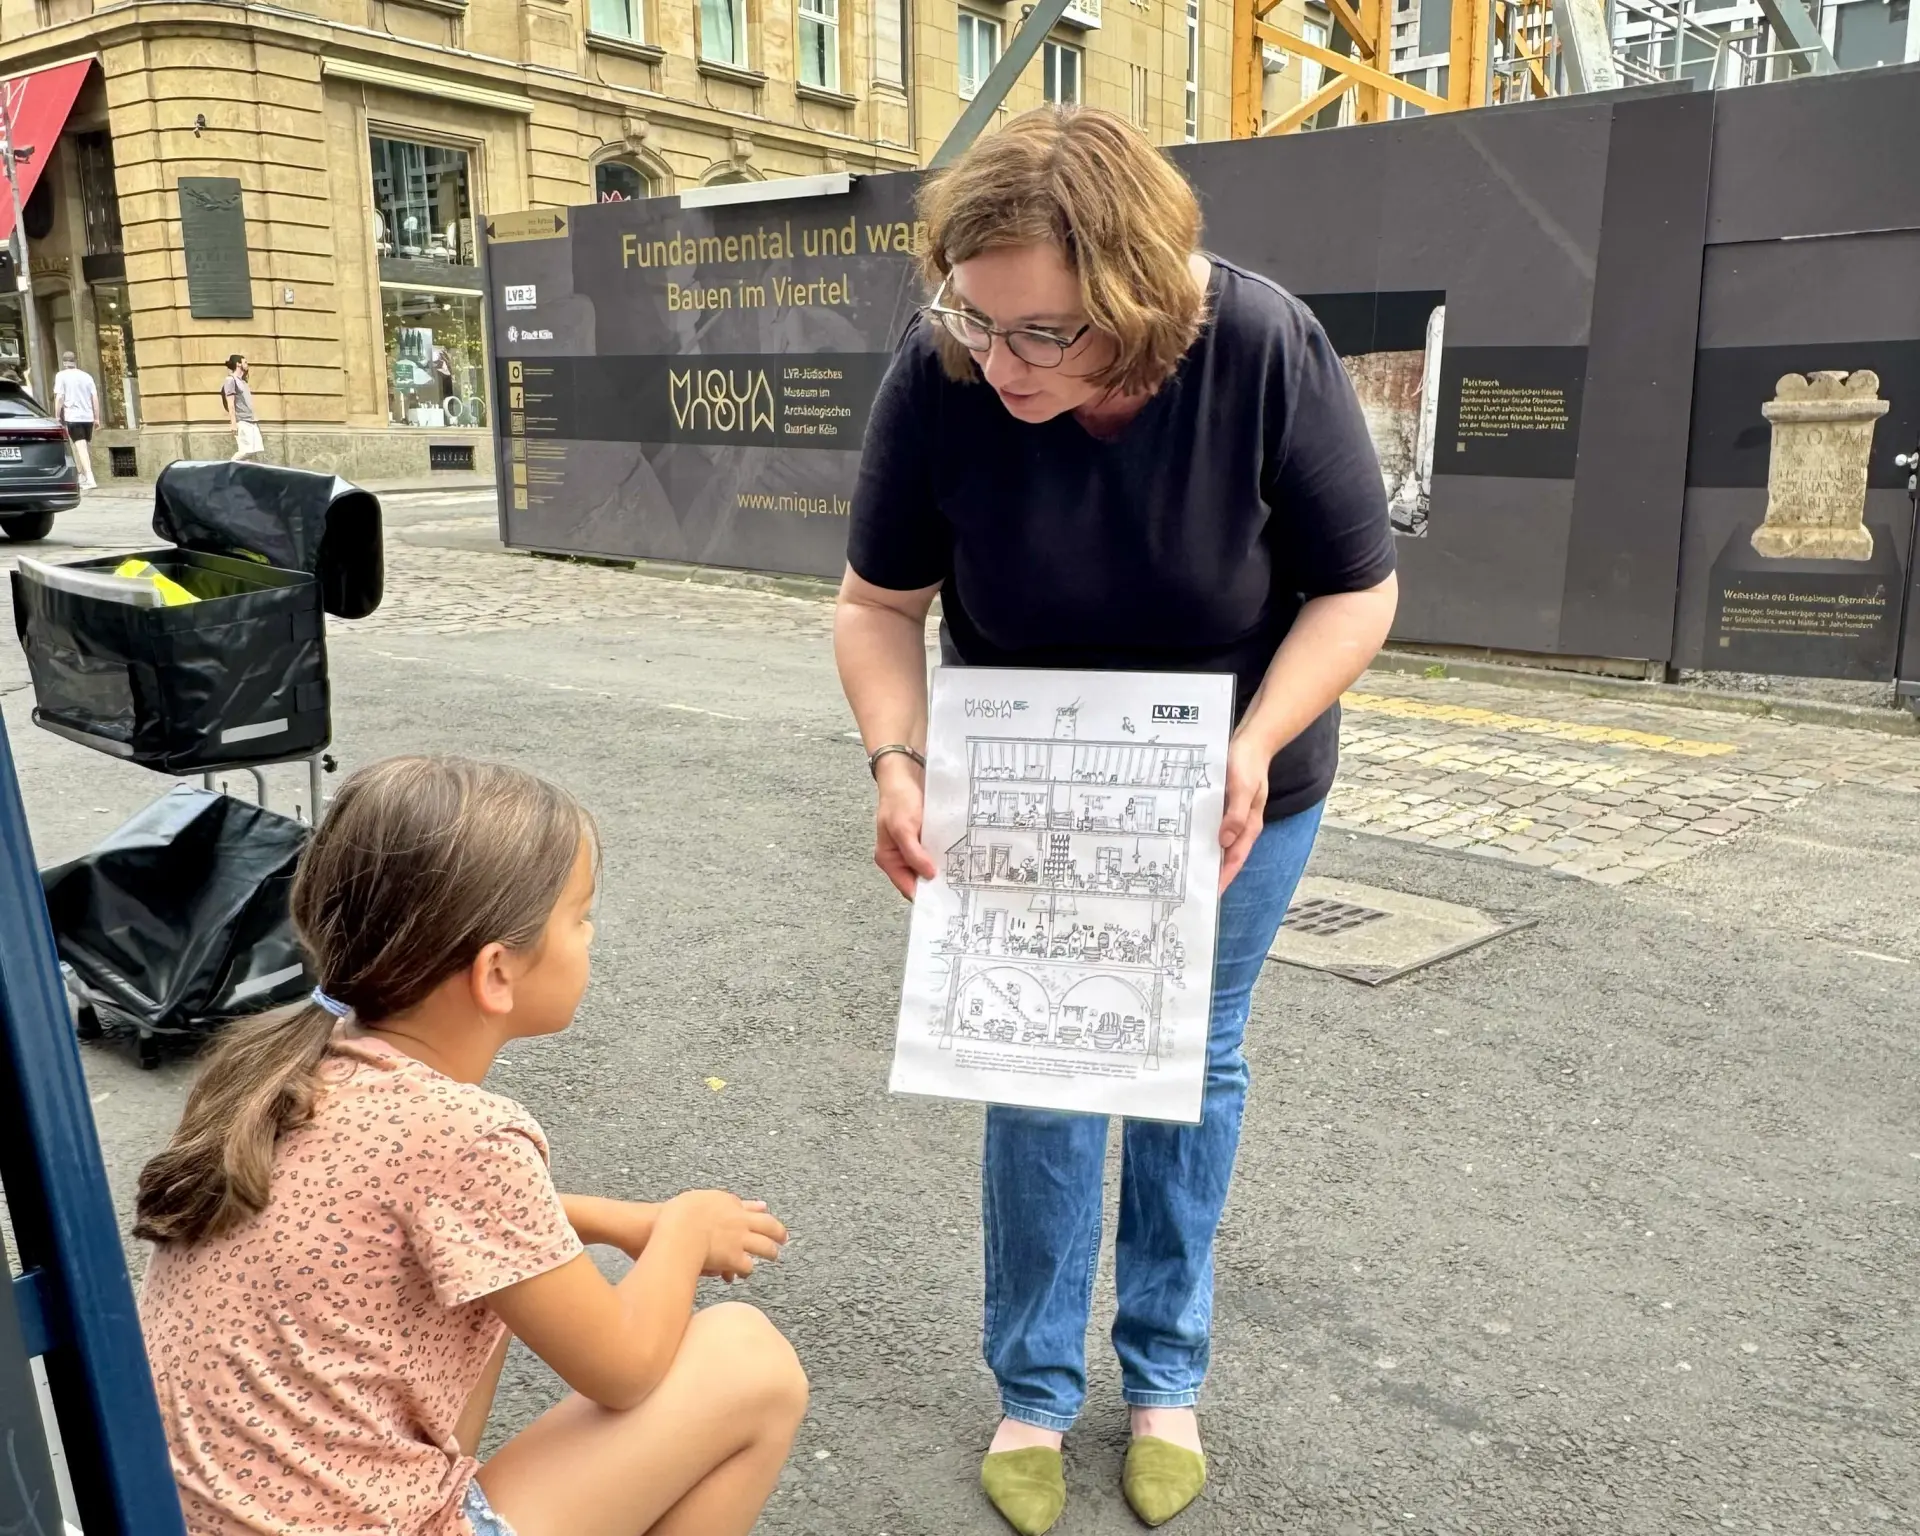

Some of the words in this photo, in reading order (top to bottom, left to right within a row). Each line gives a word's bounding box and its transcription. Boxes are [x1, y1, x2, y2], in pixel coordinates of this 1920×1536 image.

[622, 220, 795, 269] Fundamental
[803, 215, 856, 257] und
[667, 283, 732, 311] Bauen
[739, 280, 766, 308] im
[772, 274, 851, 307] Viertel
[783, 386, 818, 398] Museum
[783, 404, 851, 419] Archäologischen
[1153, 705, 1182, 719] LVR
